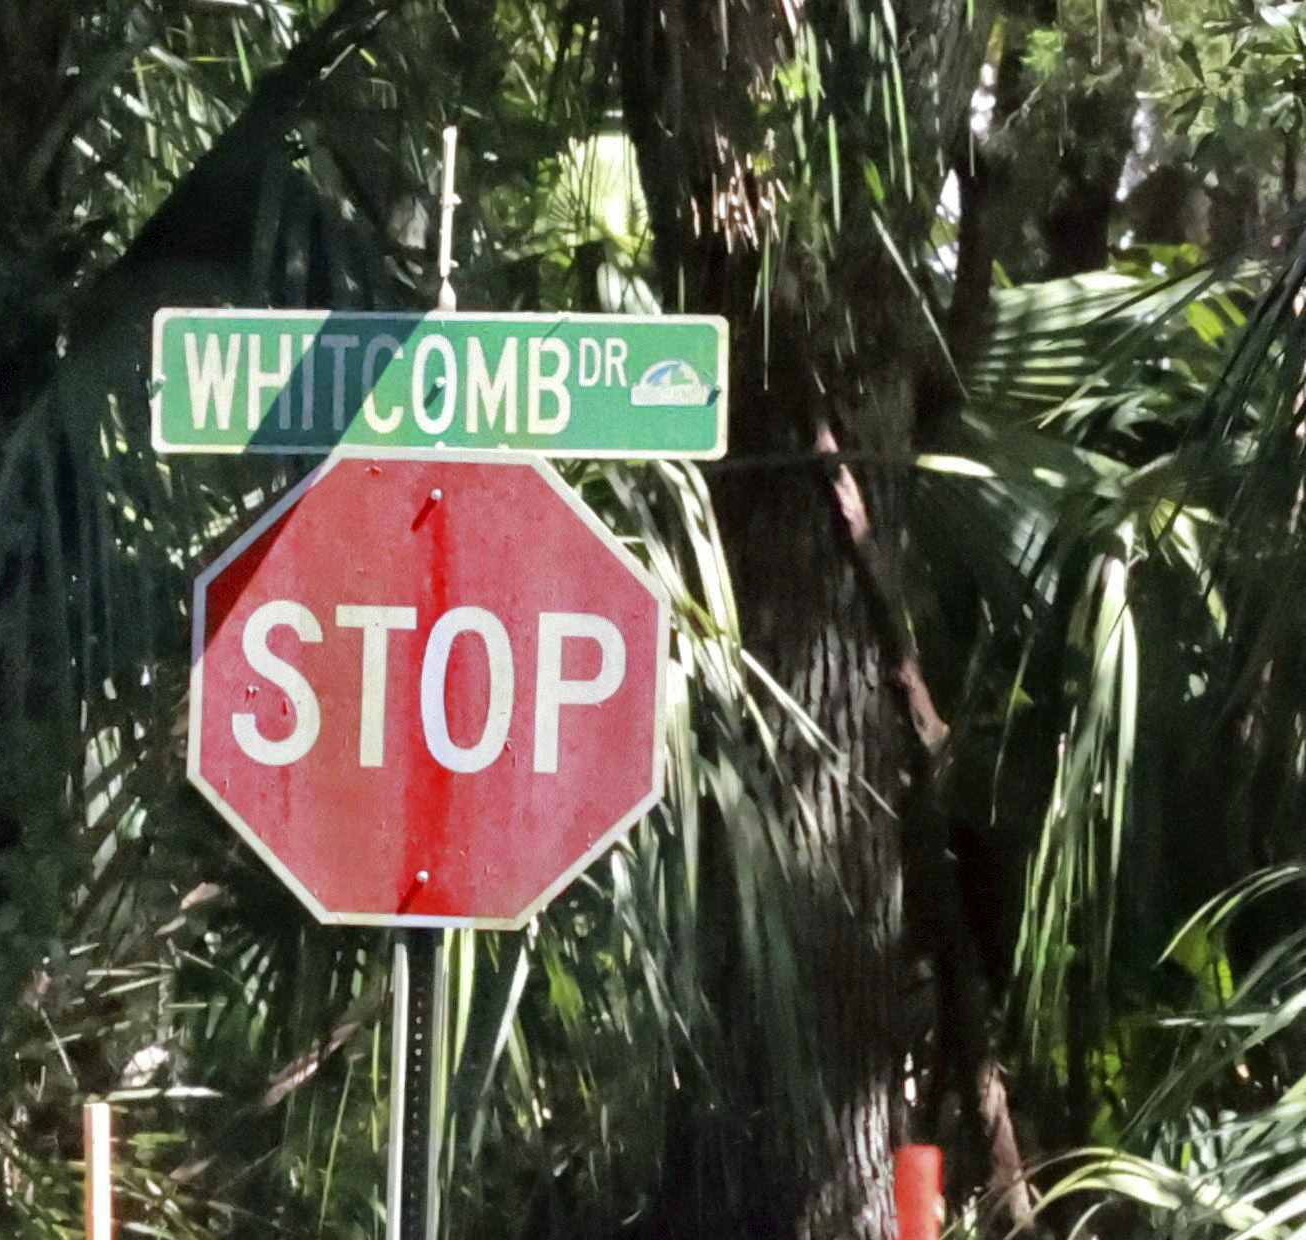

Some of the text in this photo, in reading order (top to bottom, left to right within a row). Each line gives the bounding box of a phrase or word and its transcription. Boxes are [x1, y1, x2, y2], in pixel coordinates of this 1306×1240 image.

[184, 332, 628, 436] WHITCOMB DR
[231, 599, 627, 774] STOP
